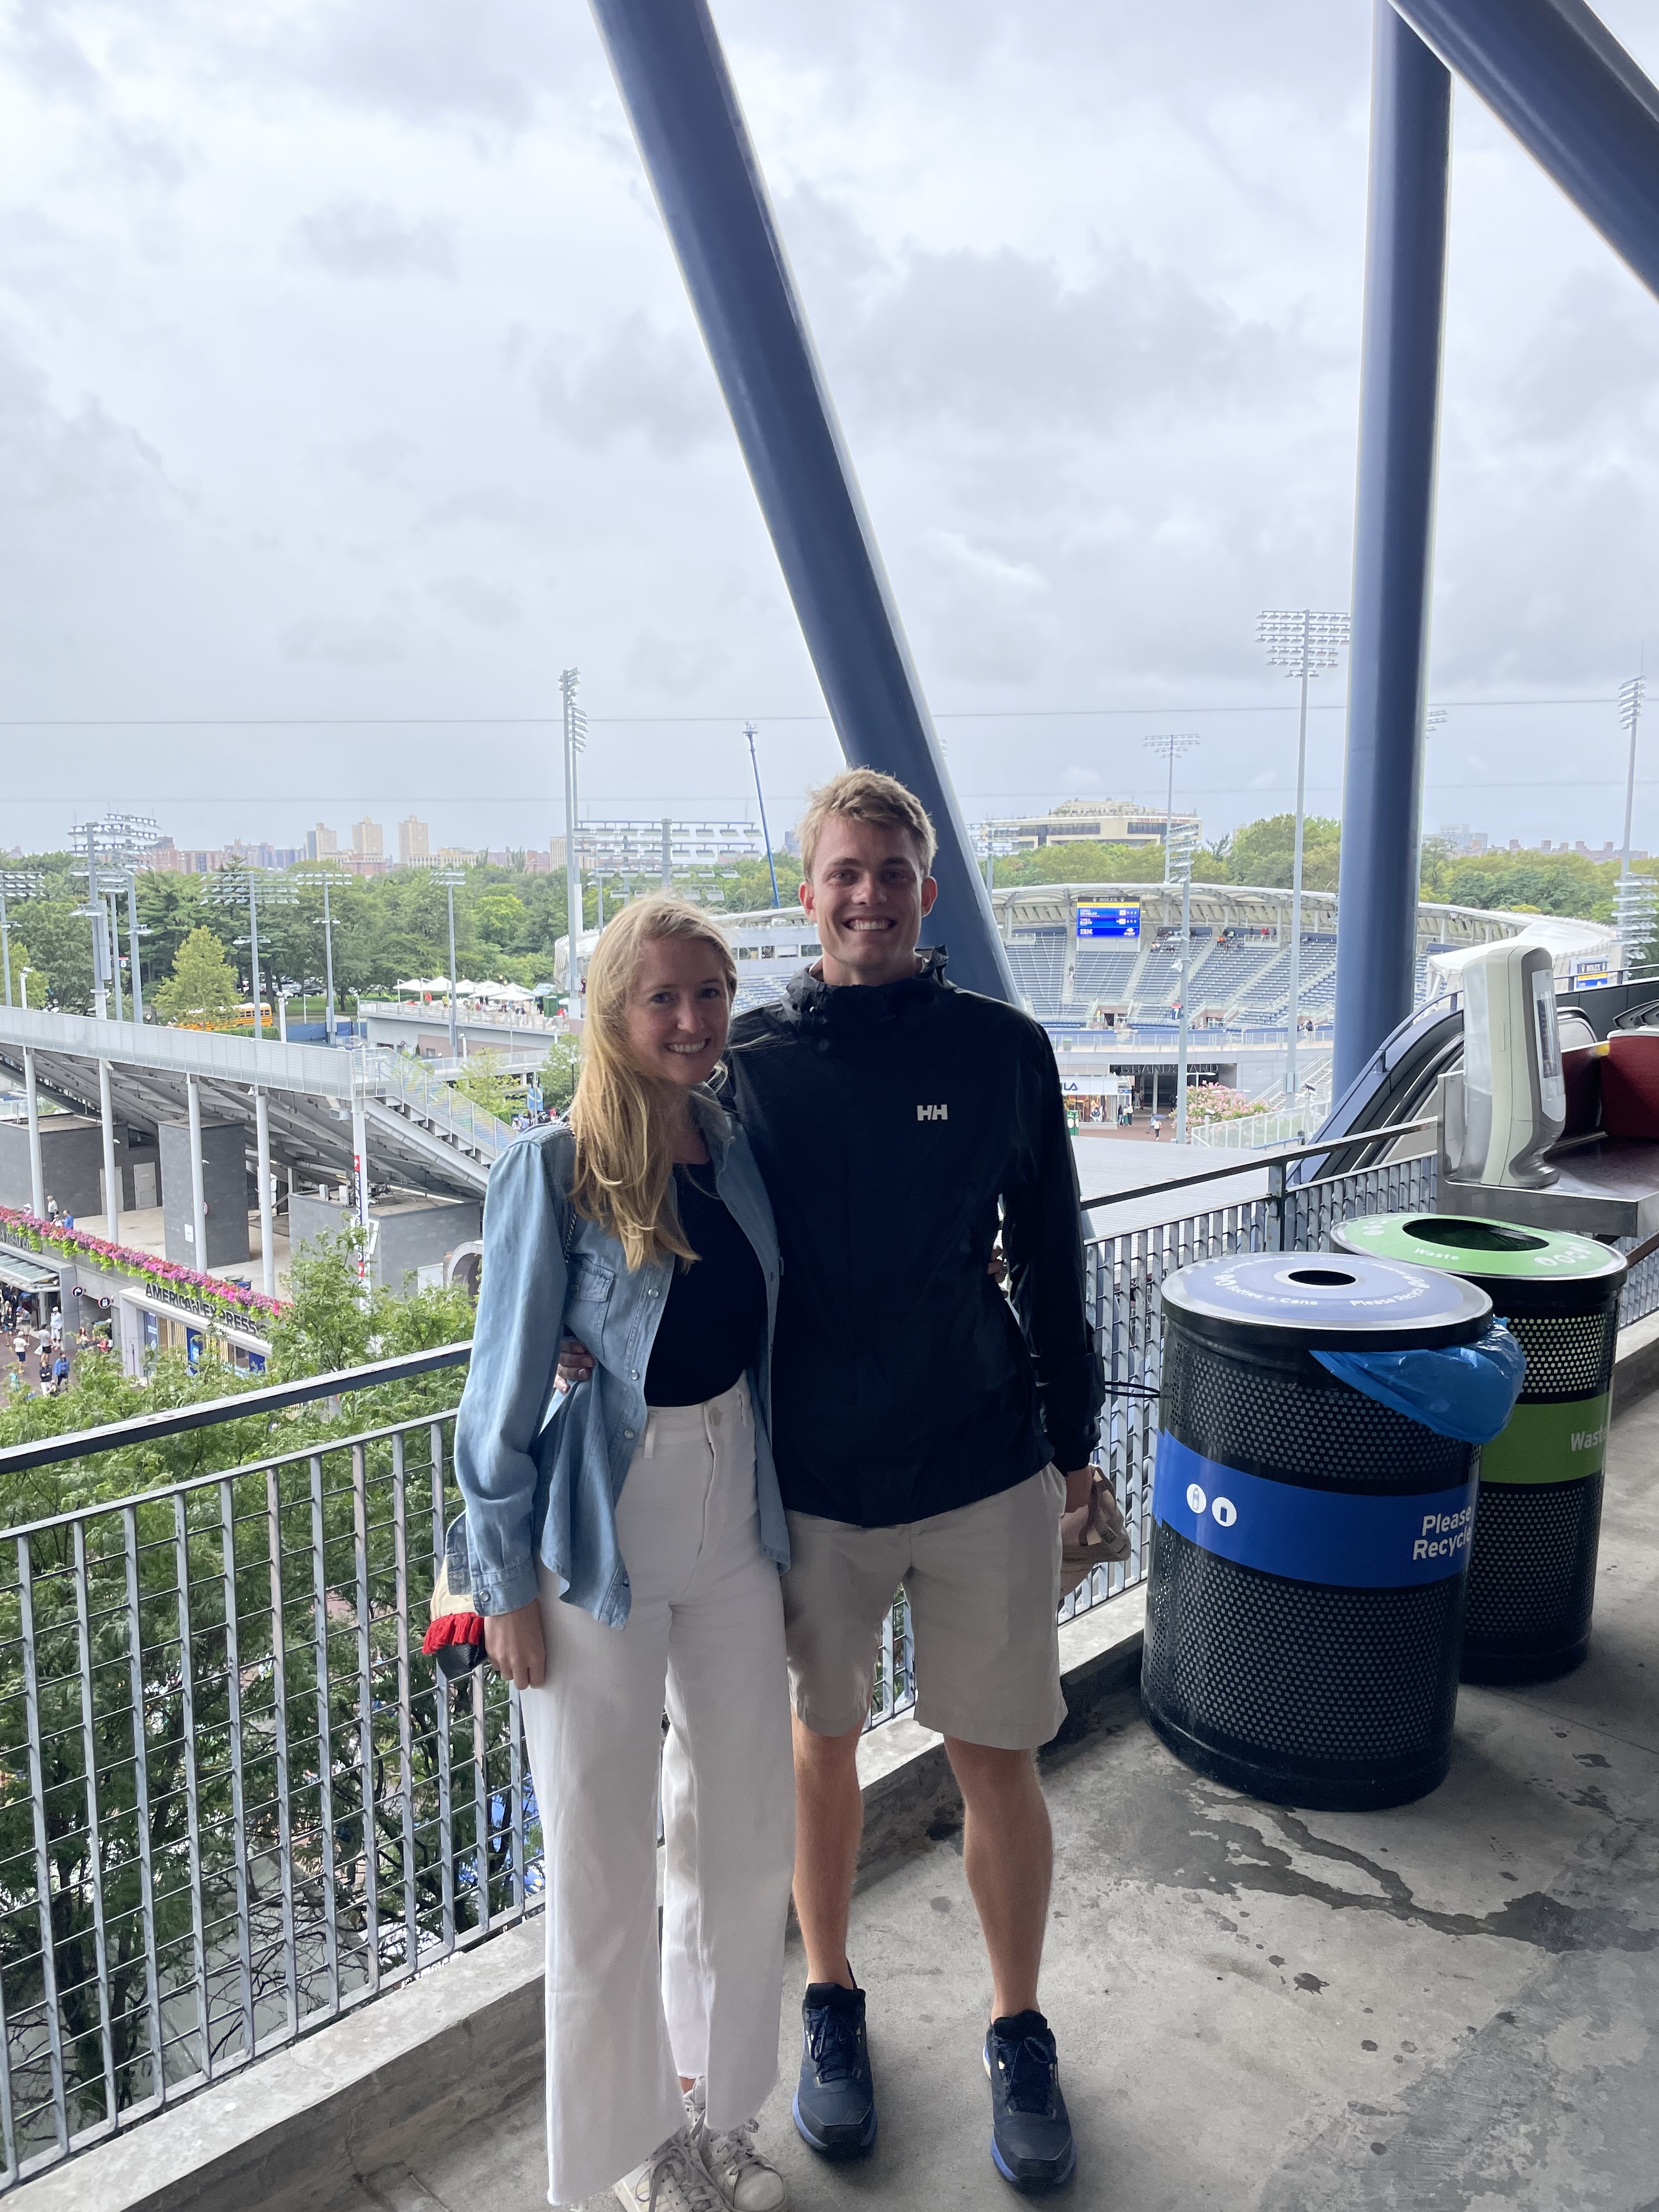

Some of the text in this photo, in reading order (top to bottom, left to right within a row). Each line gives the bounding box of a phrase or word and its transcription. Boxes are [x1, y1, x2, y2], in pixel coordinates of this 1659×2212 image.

[1174, 1008, 1180, 1019] 7
[1121, 1064, 1219, 1074] GRANDSAND
[917, 1104, 948, 1121] HH
[1414, 1248, 1460, 1261] Waste
[1226, 1285, 1264, 1299] Bottles
[145, 1283, 205, 1317] AMERICAN
[1349, 1298, 1397, 1307] Please
[1422, 1506, 1472, 1536] Please
[1413, 1525, 1471, 1560] Recycle
